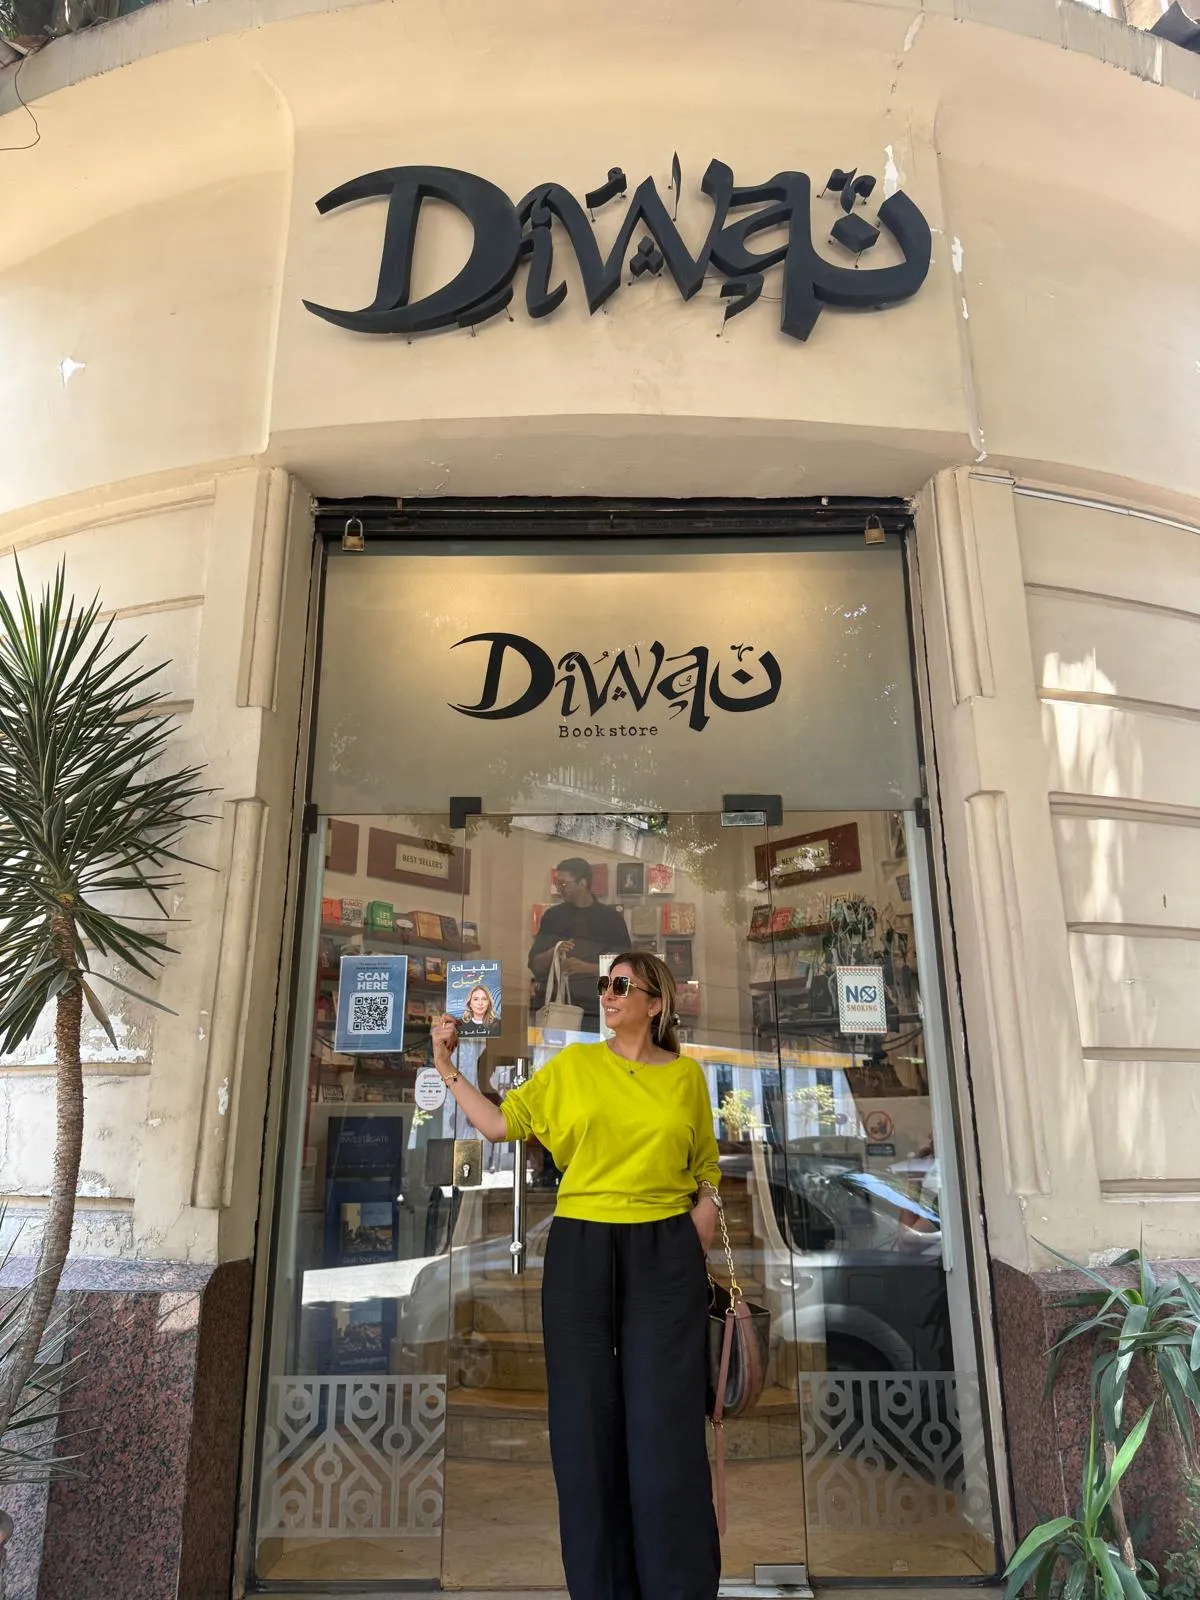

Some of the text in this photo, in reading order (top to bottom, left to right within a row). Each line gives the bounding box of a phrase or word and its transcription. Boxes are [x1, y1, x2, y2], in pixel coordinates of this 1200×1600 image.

[558, 724, 659, 738] Bookstore
[402, 854, 443, 868] BEST SELLERS
[451, 963, 498, 973] القيادة
[357, 972, 389, 981] SCAN
[357, 981, 388, 990] HERE
[845, 985, 877, 1003] NO
[846, 1003, 878, 1012] SMOKING
